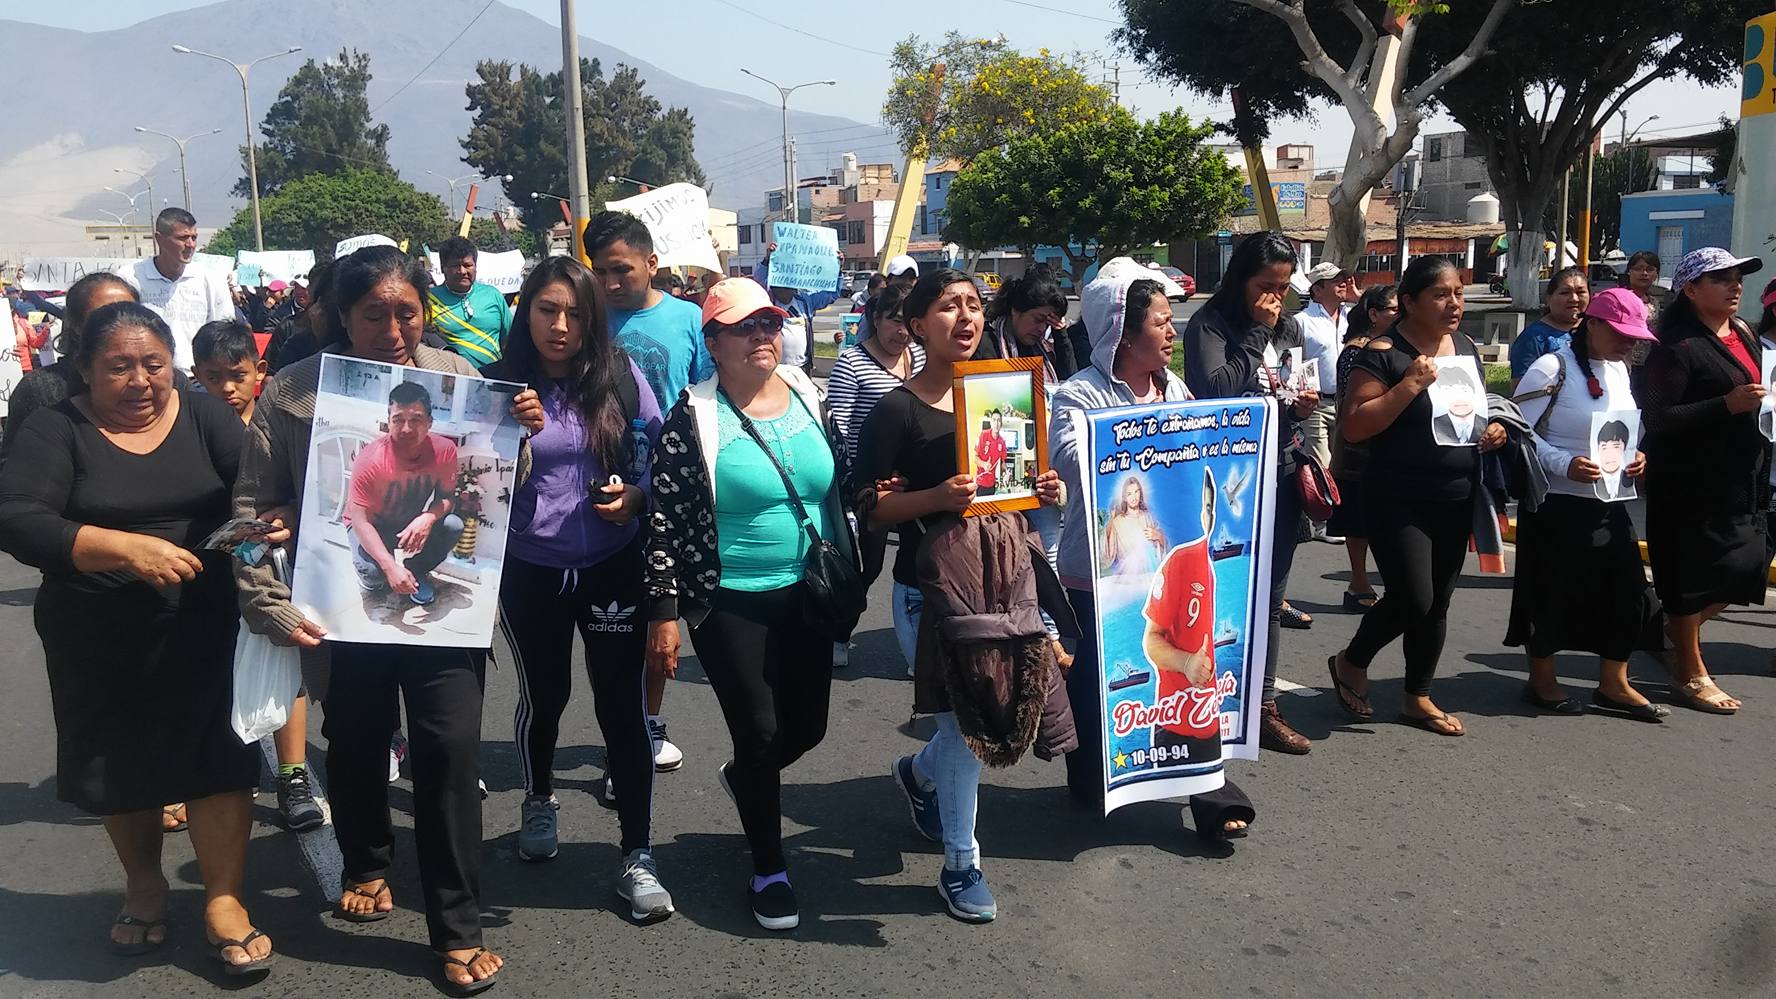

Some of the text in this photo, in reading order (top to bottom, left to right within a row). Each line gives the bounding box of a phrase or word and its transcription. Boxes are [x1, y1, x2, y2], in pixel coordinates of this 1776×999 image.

[1113, 421, 1143, 445] Todos
[1221, 409, 1229, 427] la
[1099, 456, 1117, 474] sin
[1221, 438, 1229, 455] la
[587, 622, 634, 632] adidas
[1186, 597, 1201, 628] 9
[1113, 693, 1188, 735] David
[1131, 744, 1190, 766] 10-09-94
